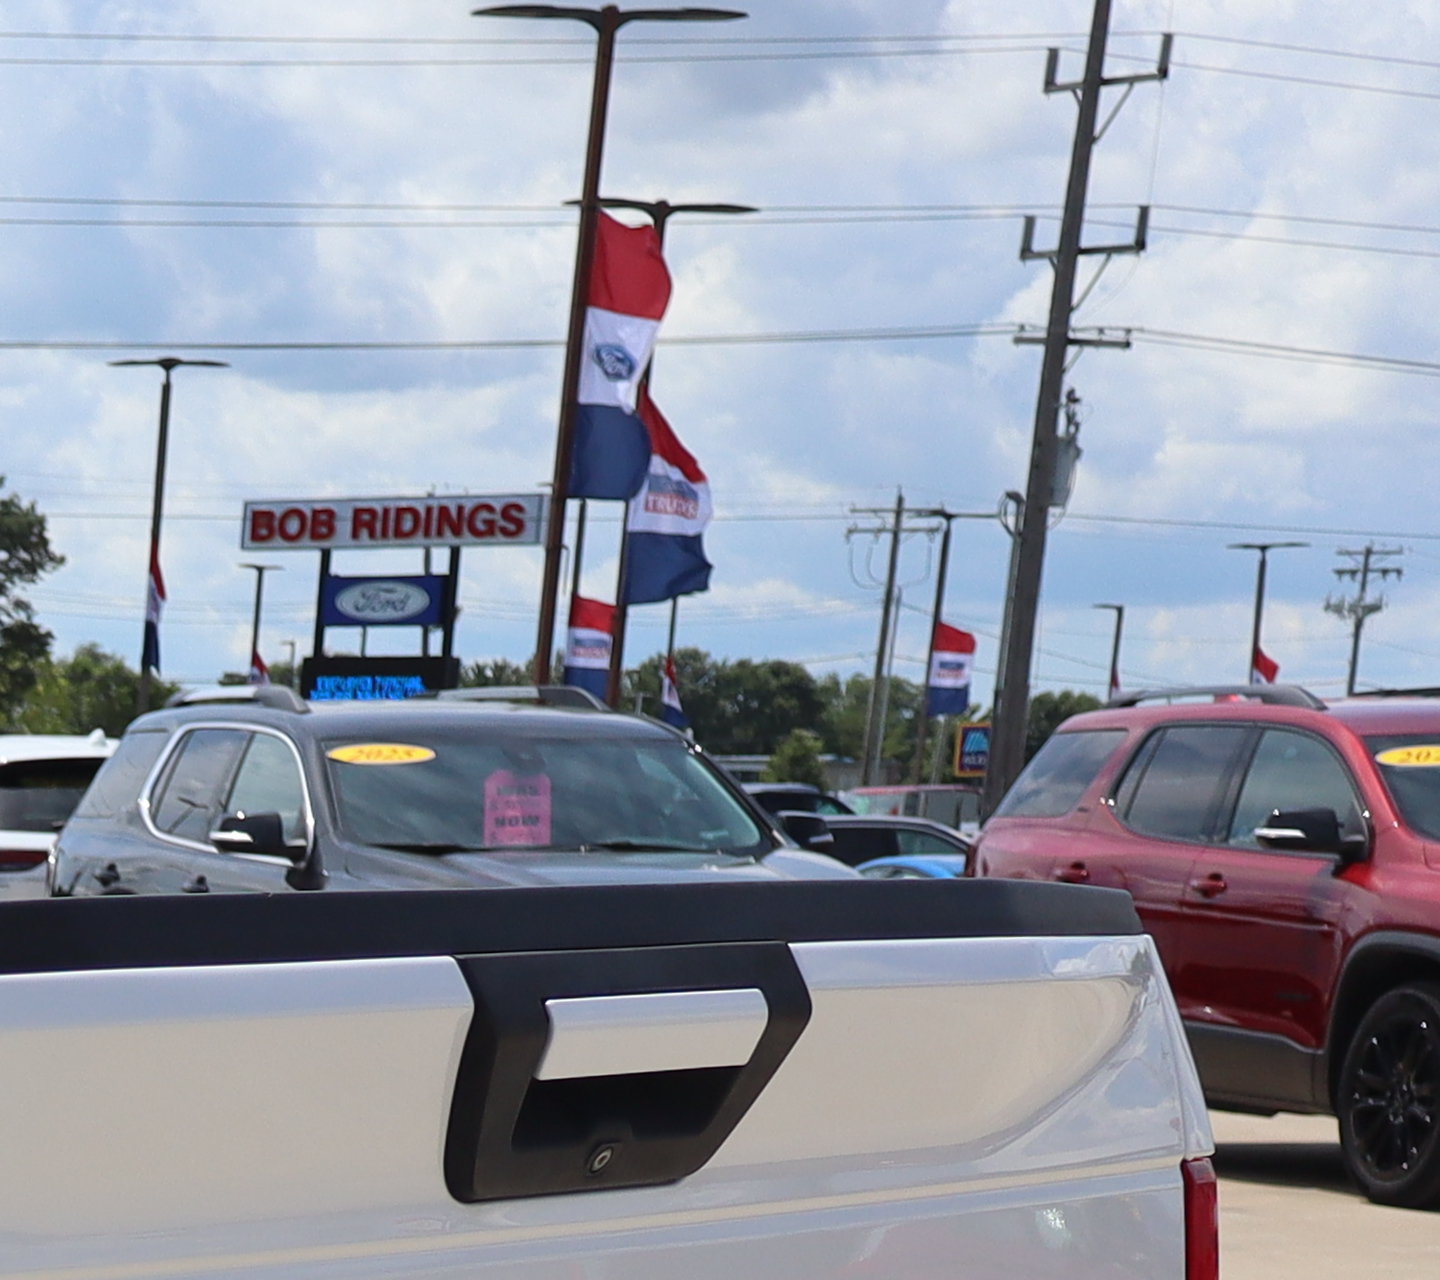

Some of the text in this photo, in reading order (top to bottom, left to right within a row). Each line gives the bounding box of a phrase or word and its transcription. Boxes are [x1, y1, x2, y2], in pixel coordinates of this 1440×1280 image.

[250, 502, 527, 543] BOB RIDINGS
[353, 588, 411, 614] Ford
